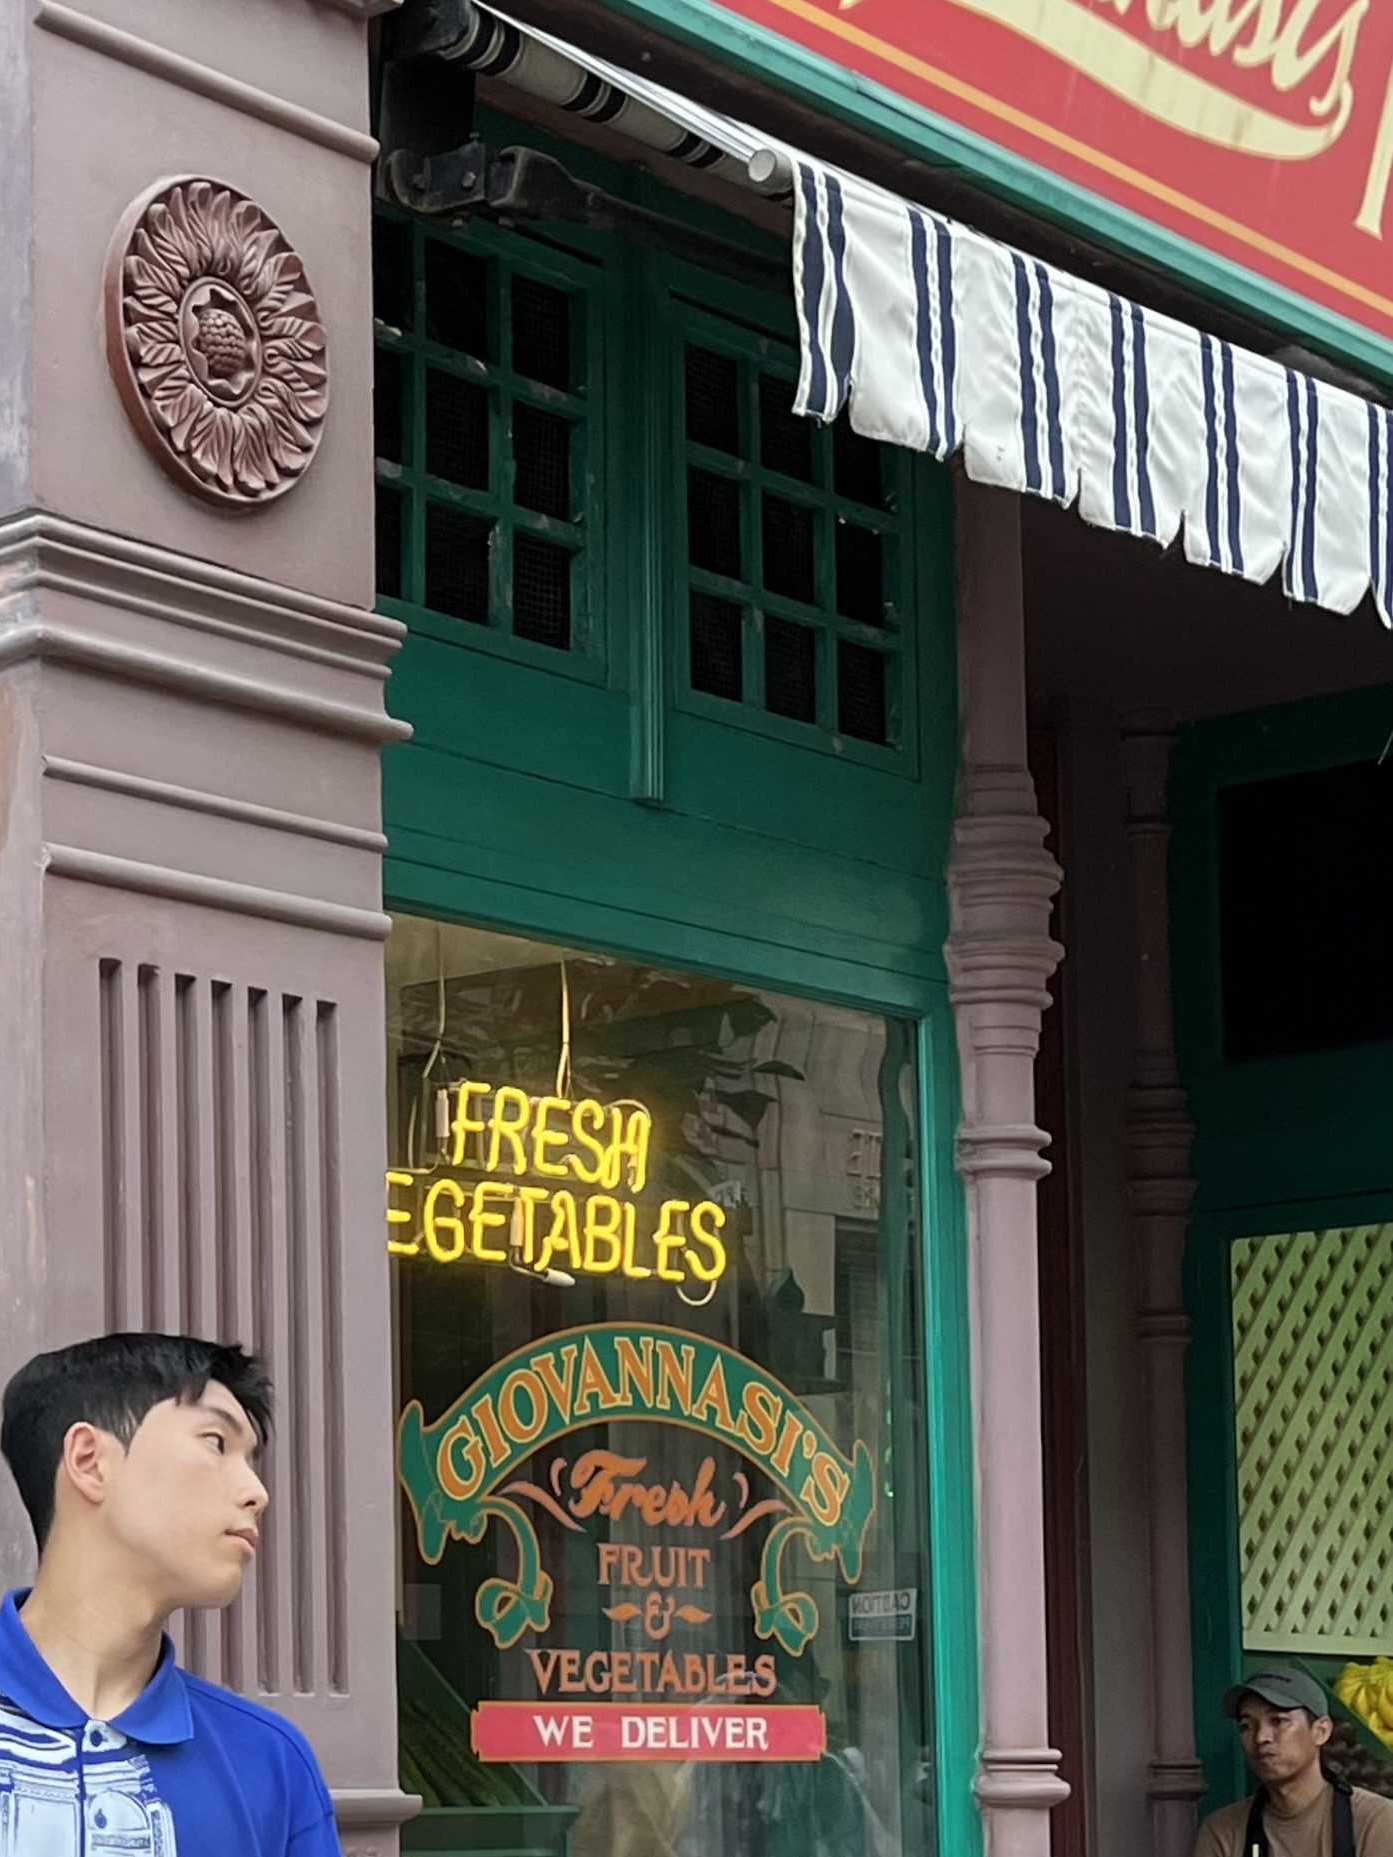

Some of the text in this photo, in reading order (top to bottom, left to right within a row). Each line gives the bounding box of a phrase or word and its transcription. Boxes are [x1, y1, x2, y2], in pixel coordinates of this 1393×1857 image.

[451, 1081, 652, 1194] FRESH
[437, 1335, 850, 1526] GIOVANNASI'S
[568, 1449, 727, 1527] Fresh
[597, 1543, 711, 1588] FRUIT
[644, 1591, 676, 1640] &
[524, 1649, 777, 1697] VEGETABLES
[533, 1715, 769, 1751] WE DELIVER
